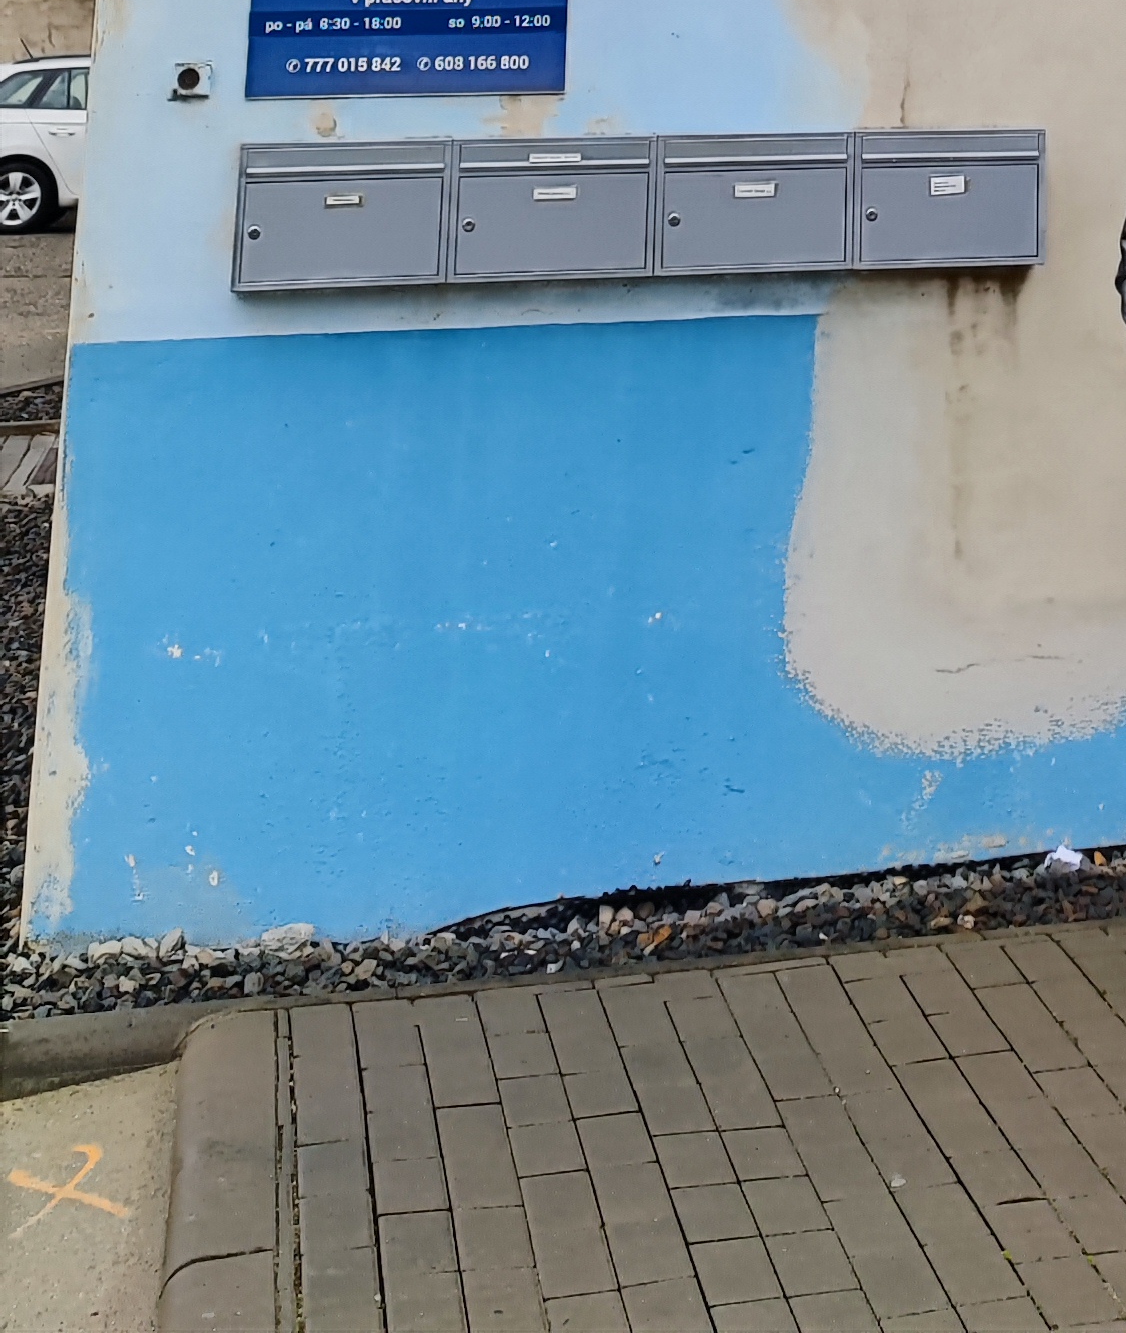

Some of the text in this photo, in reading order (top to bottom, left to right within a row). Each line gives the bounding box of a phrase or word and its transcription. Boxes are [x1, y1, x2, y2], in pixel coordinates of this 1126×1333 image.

[265, 21, 283, 33] po
[295, 18, 312, 33] pá
[319, 17, 350, 29] 8:30
[363, 16, 401, 29] 18:00
[448, 18, 465, 28] so
[471, 15, 501, 28] 9:00
[514, 14, 551, 27] 12:00
[304, 56, 401, 72] 777 015 842
[434, 55, 464, 71] 608
[468, 55, 497, 70] 166
